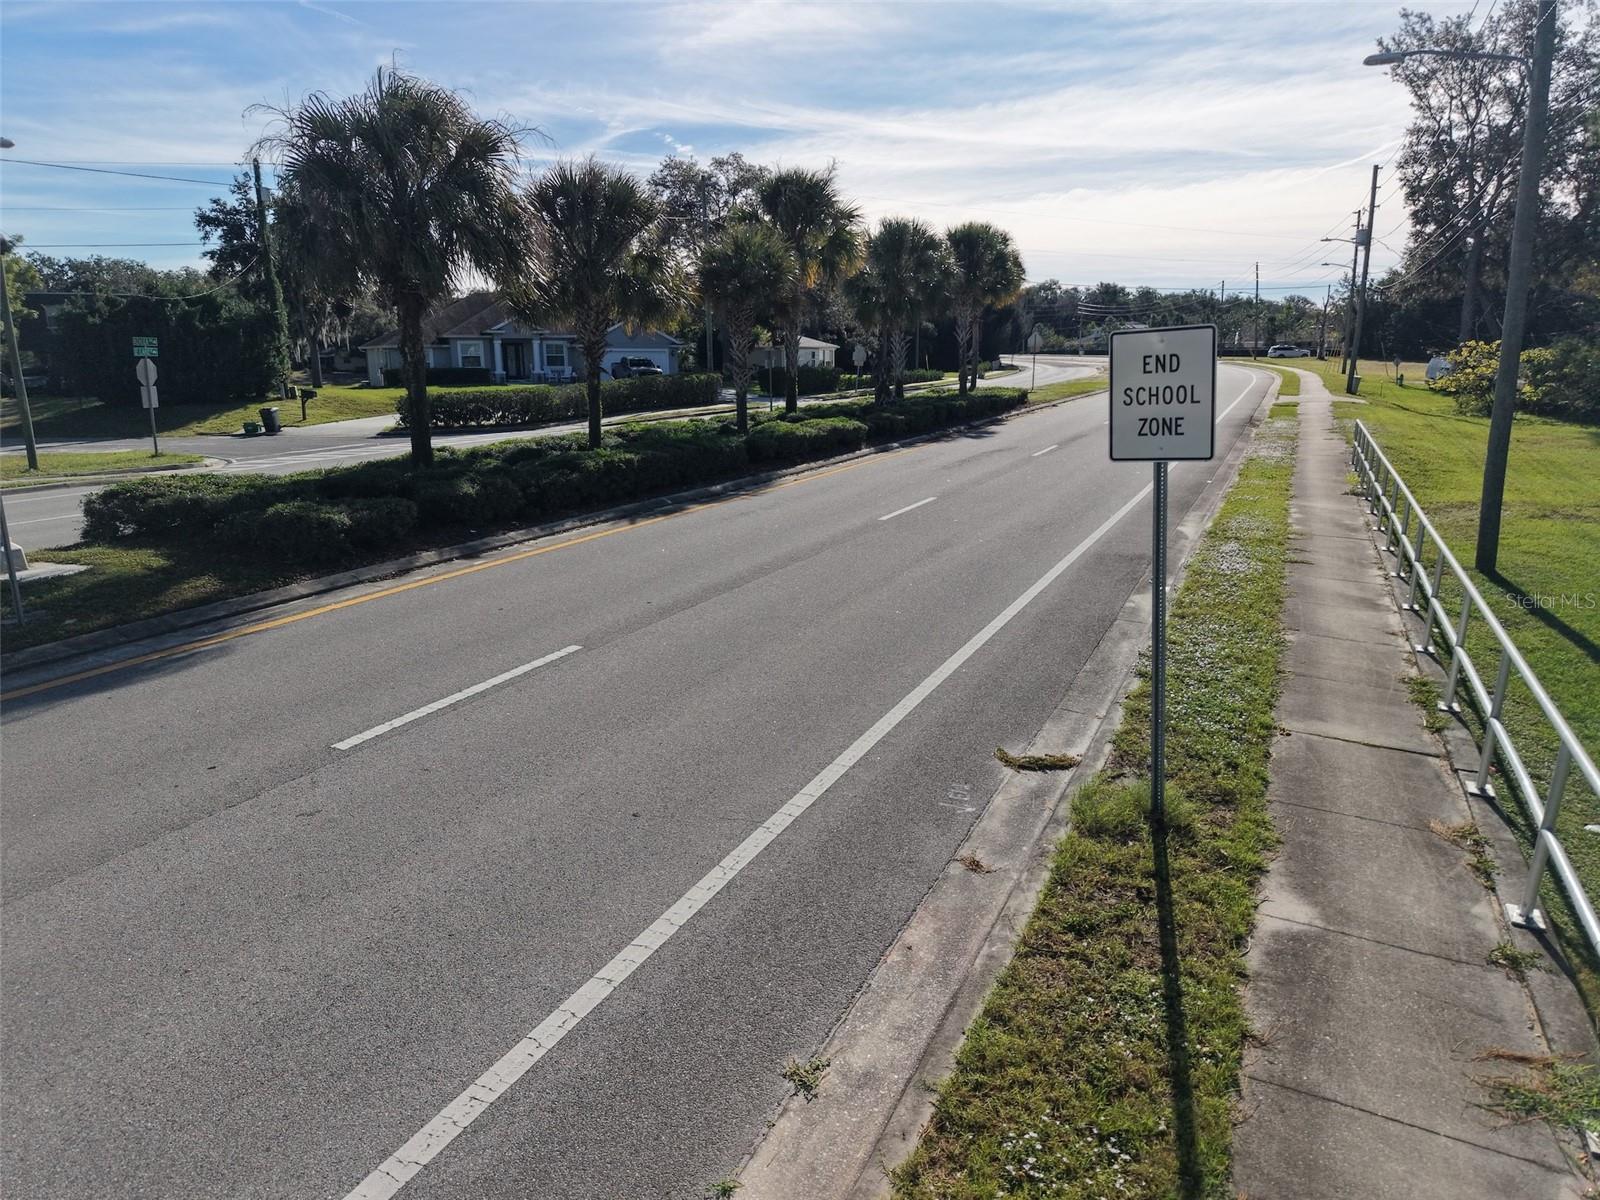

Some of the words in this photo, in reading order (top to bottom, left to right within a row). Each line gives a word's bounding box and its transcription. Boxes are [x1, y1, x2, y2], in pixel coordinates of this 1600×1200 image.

[1143, 353, 1180, 374] END
[1123, 384, 1201, 406] SCHOOL
[1137, 417, 1185, 437] ZONE
